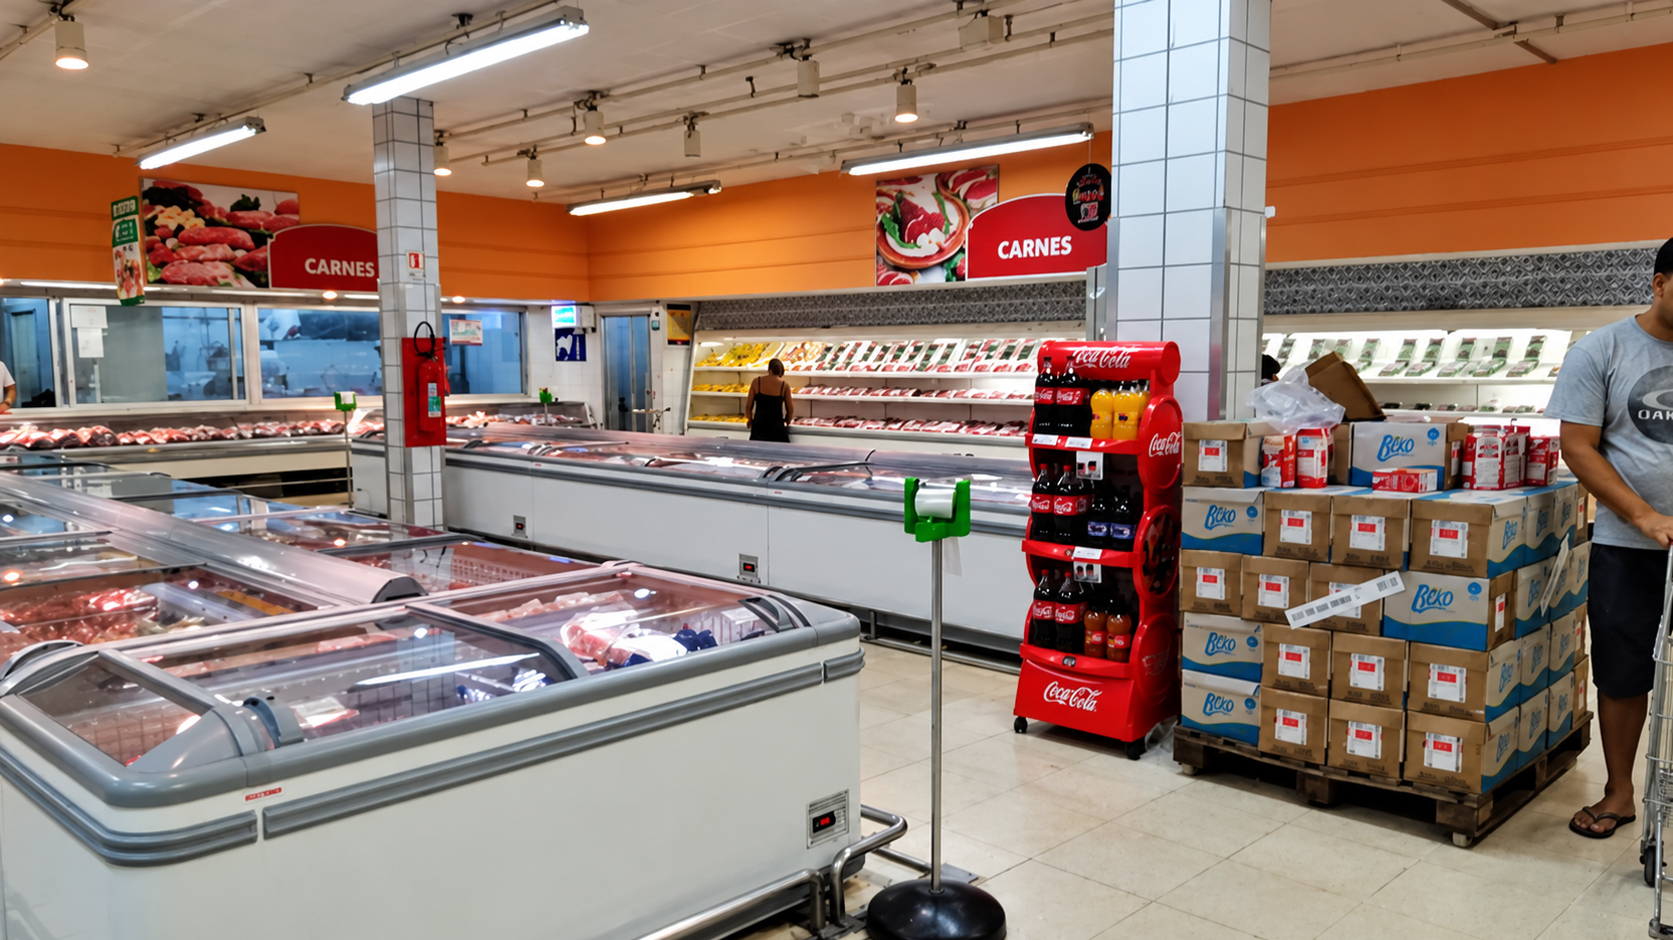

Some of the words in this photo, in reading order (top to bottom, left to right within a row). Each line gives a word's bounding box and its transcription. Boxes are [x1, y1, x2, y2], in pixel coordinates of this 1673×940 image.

[997, 235, 1072, 260] CARNES
[304, 257, 375, 278] CARNES
[1411, 584, 1454, 614] Beko
